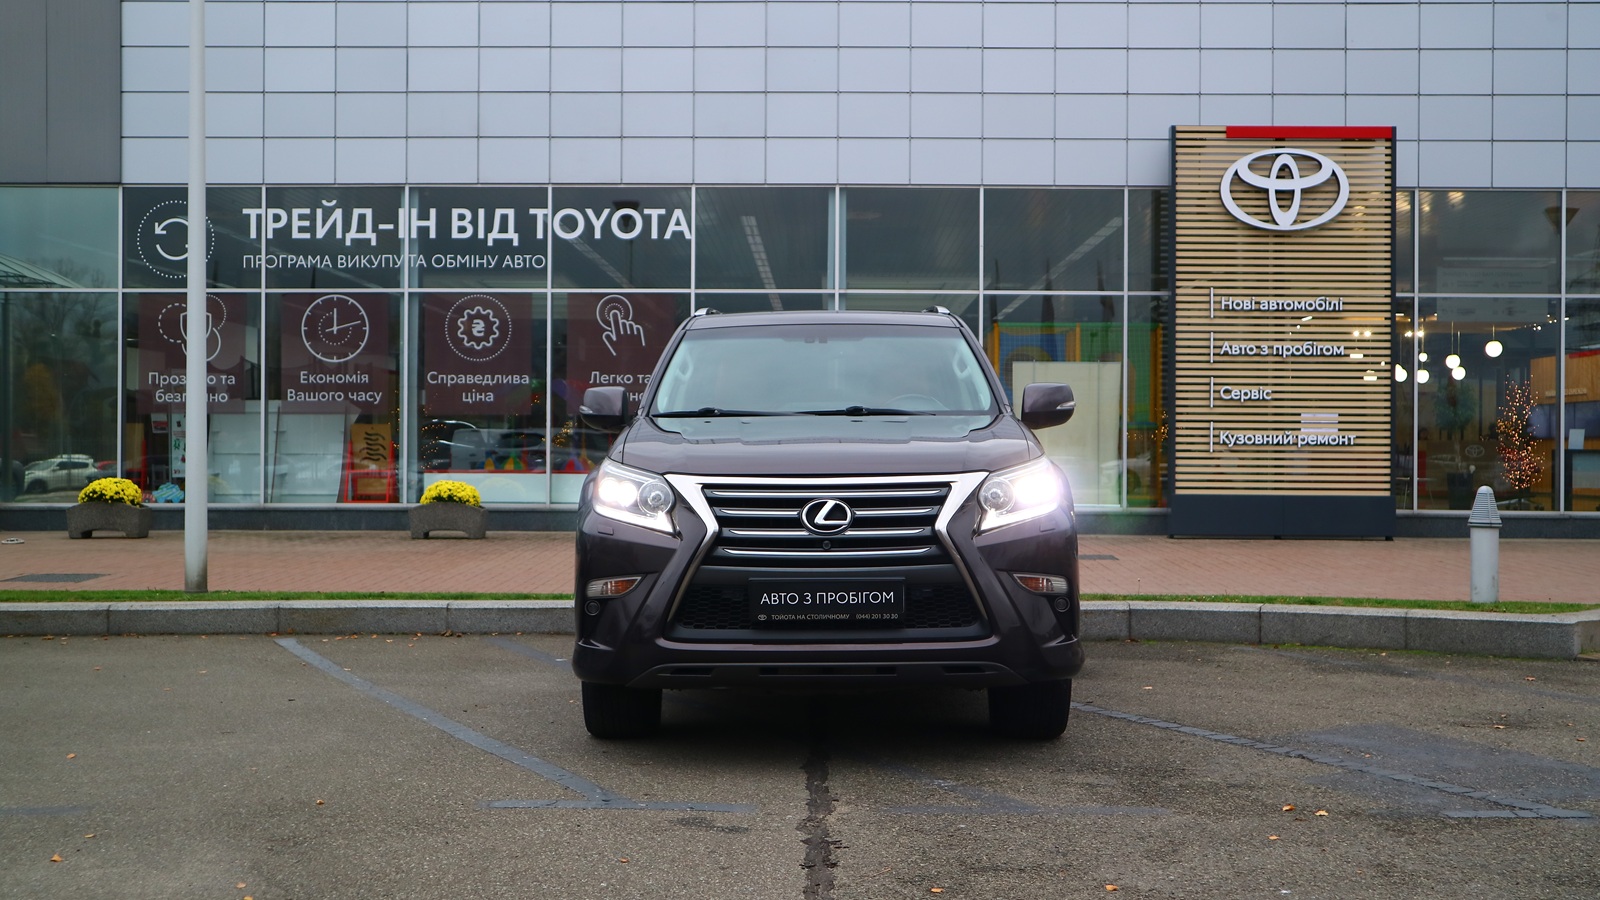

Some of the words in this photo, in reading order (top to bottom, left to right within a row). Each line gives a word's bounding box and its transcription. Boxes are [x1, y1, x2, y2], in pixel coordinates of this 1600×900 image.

[242, 199, 436, 246] ТРЕЙД-ІН
[451, 208, 519, 246] ВІД
[529, 208, 692, 239] TOYOTA
[243, 254, 333, 268] ПРОГРАМА
[337, 254, 404, 268] ВИКУПУ
[408, 254, 427, 268] ТА
[431, 254, 498, 268] ОБМІНУ
[502, 254, 546, 268] АВТО
[1221, 296, 1255, 311] Нові
[1260, 297, 1344, 311] автомобілі
[1220, 341, 1257, 355] Авто
[1260, 344, 1269, 355] з
[1273, 341, 1345, 358] пробігом
[148, 372, 216, 388] Прозо
[220, 374, 236, 385] та
[299, 371, 369, 384] Економія
[426, 371, 530, 387] Справедлива
[589, 371, 633, 384] Легко
[287, 389, 344, 402] Вашого
[348, 391, 382, 405] часу
[462, 389, 494, 403] ціна
[1219, 385, 1272, 403] Сервіс
[1219, 430, 1294, 448] Кузовний
[1297, 434, 1357, 448] ремонт
[760, 592, 799, 605] АВТО
[803, 592, 812, 605] З
[816, 591, 894, 604] ПРОБІГОМ
